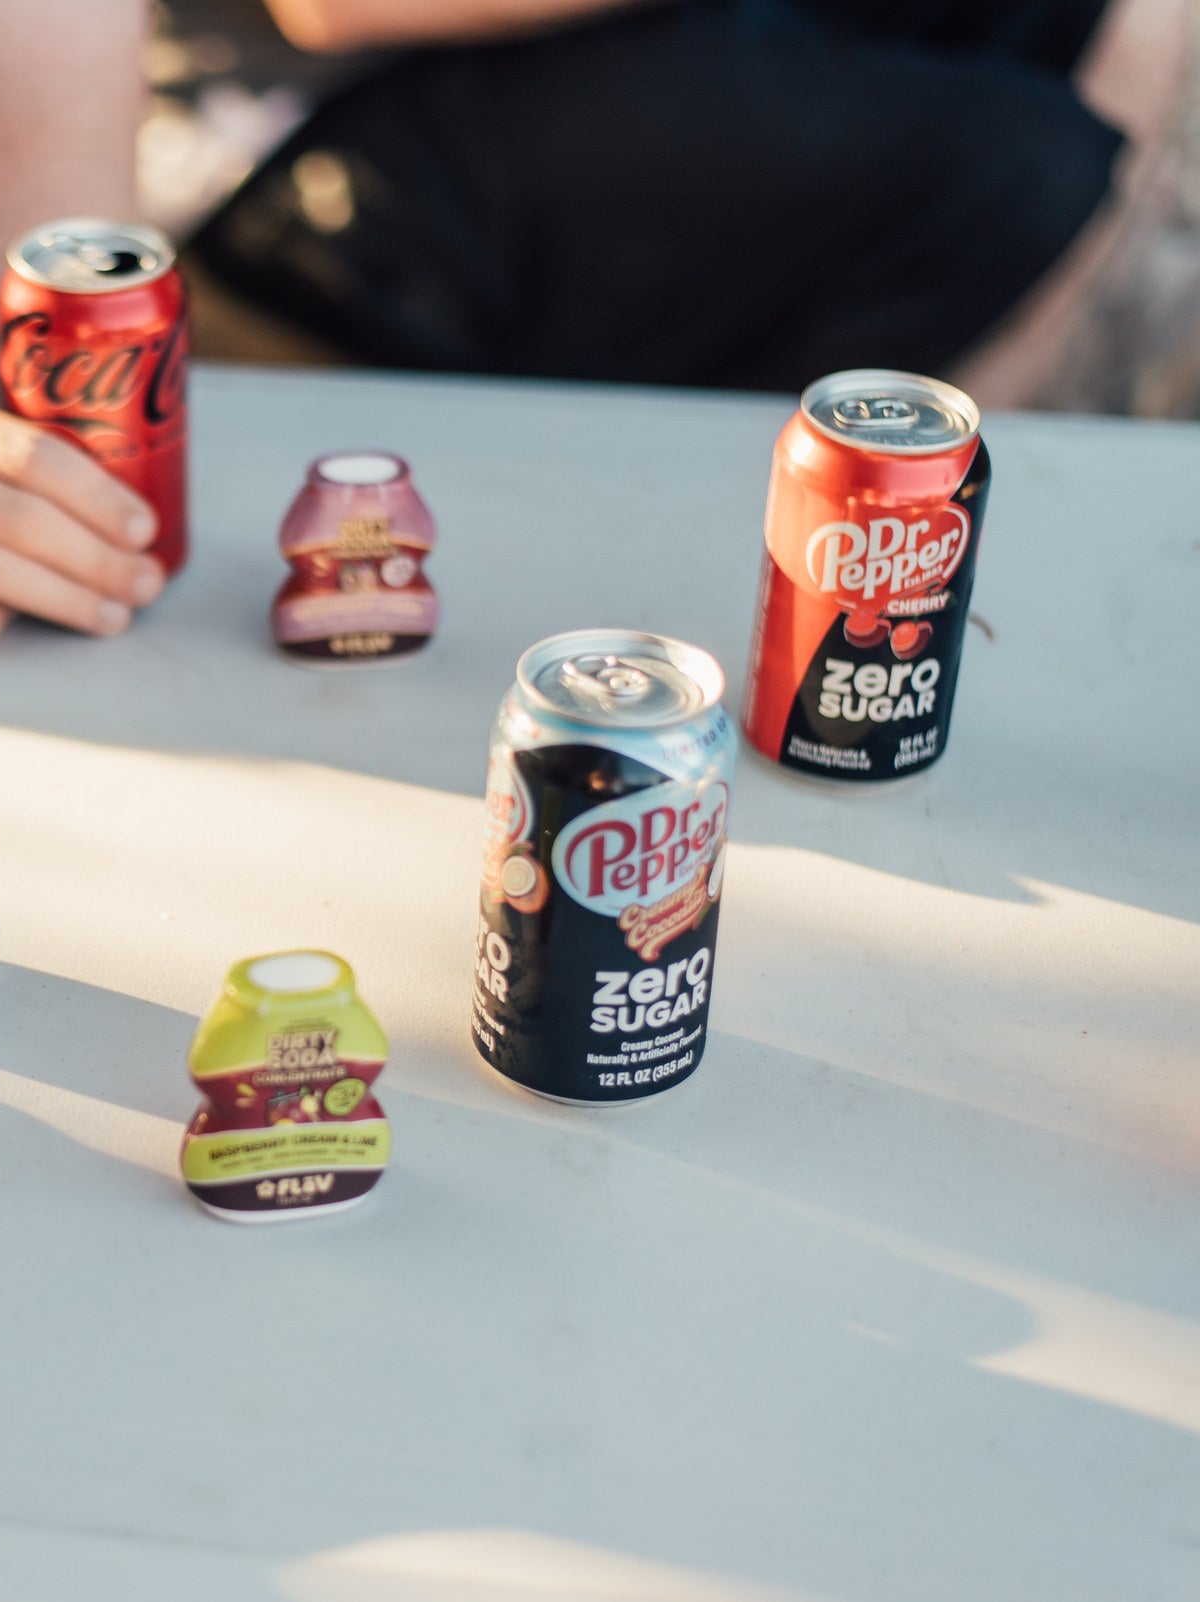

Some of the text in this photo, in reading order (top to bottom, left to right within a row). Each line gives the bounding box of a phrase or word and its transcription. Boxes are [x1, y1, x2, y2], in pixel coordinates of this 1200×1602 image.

[869, 517, 930, 561] Dr
[806, 521, 960, 600] Pepper
[887, 592, 950, 614] CHERRY
[822, 657, 941, 698] zero
[818, 689, 936, 723] SUGAR
[641, 801, 700, 854] Dr
[565, 802, 723, 898] Pepper
[593, 948, 710, 1005] zero
[590, 980, 707, 1033] SUGAR
[266, 1046, 336, 1070] SODA
[267, 1029, 339, 1051] DIRTY
[587, 1053, 629, 1065] Naturally
[630, 1054, 637, 1063] &
[639, 1043, 679, 1061] Artificially
[621, 1027, 685, 1052] Creamy Coconut
[598, 1073, 615, 1086] 12
[617, 1072, 632, 1085] FL
[634, 1068, 651, 1083] OZ
[652, 1060, 676, 1082] (355
